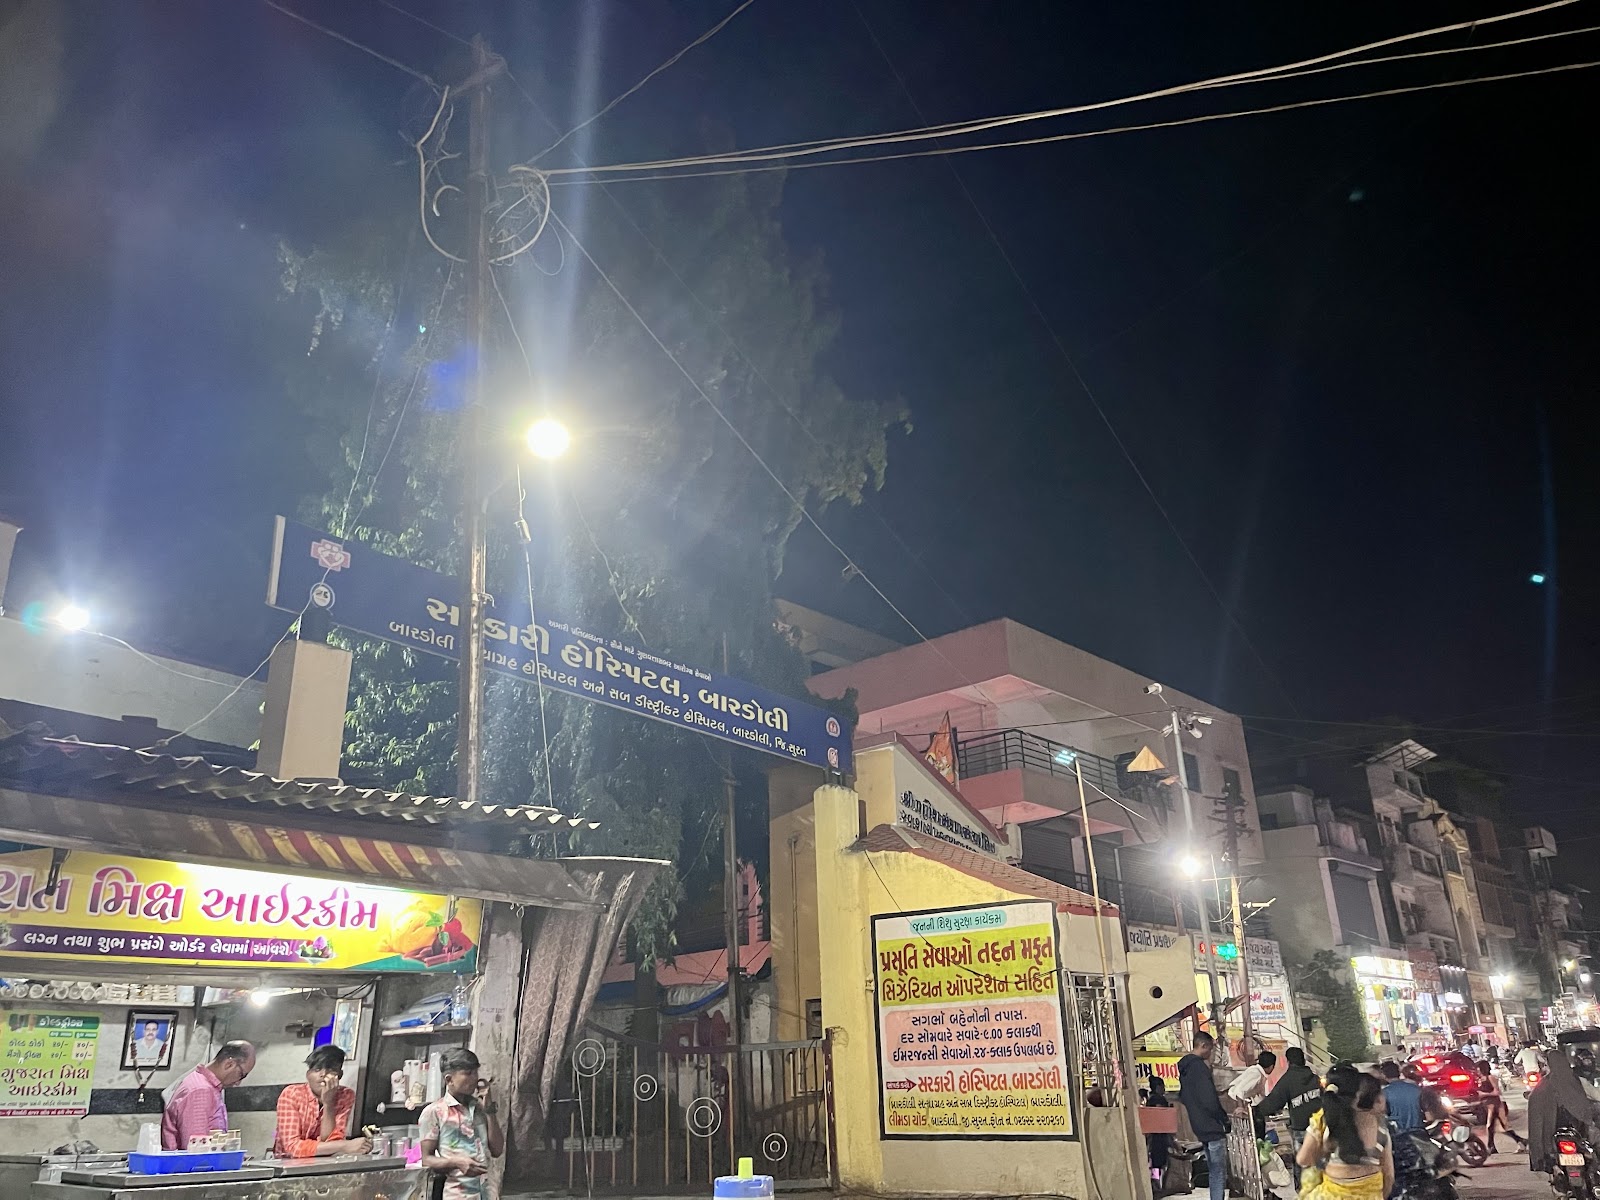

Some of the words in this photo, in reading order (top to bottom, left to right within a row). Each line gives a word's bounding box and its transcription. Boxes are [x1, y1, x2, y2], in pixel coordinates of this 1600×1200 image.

[426, 597, 549, 655] સકારી
[698, 688, 789, 732] બારડોલી
[389, 621, 455, 650] બારડોલી
[522, 659, 577, 688] હોસ્પિટલ
[582, 679, 605, 696] અને
[609, 688, 631, 703] સબ
[683, 708, 729, 735] હોસ્પિટલ,
[732, 725, 772, 748] બારડોલી,
[88, 865, 185, 921] મિક્ષ
[912, 917, 935, 931] જનની
[937, 916, 952, 931] શિશુ
[954, 916, 972, 930] સુરક્ષા
[23, 932, 58, 946] લગ્ન
[63, 935, 92, 948] તથા
[97, 936, 125, 953] શુભ
[131, 934, 165, 951] પ્રસંગે
[169, 936, 205, 954] ઓર્ડર
[210, 938, 249, 954] લેવામાં
[880, 942, 918, 976] પ્રસૂતિ
[922, 937, 973, 968] સેવાઓ
[1020, 936, 1053, 966] મફત
[882, 976, 942, 1002] સિઝેરિયન
[1014, 965, 1054, 993] સહિત
[949, 1007, 990, 1026] બહેનોની
[994, 1009, 1027, 1022] તપાસ.
[900, 1033, 914, 1043] દર
[917, 1027, 953, 1043] સોમવારે
[1006, 1022, 1042, 1039] કલાકથી
[892, 1045, 938, 1062] ઈમરજન્સી
[1013, 1042, 1045, 1057] ઉપલબ્ધ
[1045, 1040, 1057, 1056] છે.
[1, 1067, 54, 1083] ગુજરાત
[60, 1063, 90, 1080] મિક્ષ
[918, 1070, 955, 1093] સરકારી
[1012, 1065, 1067, 1092] બારડોલી,
[945, 1096, 959, 1109] અને
[960, 1099, 973, 1109] સબ
[889, 1110, 911, 1127] લીમડા
